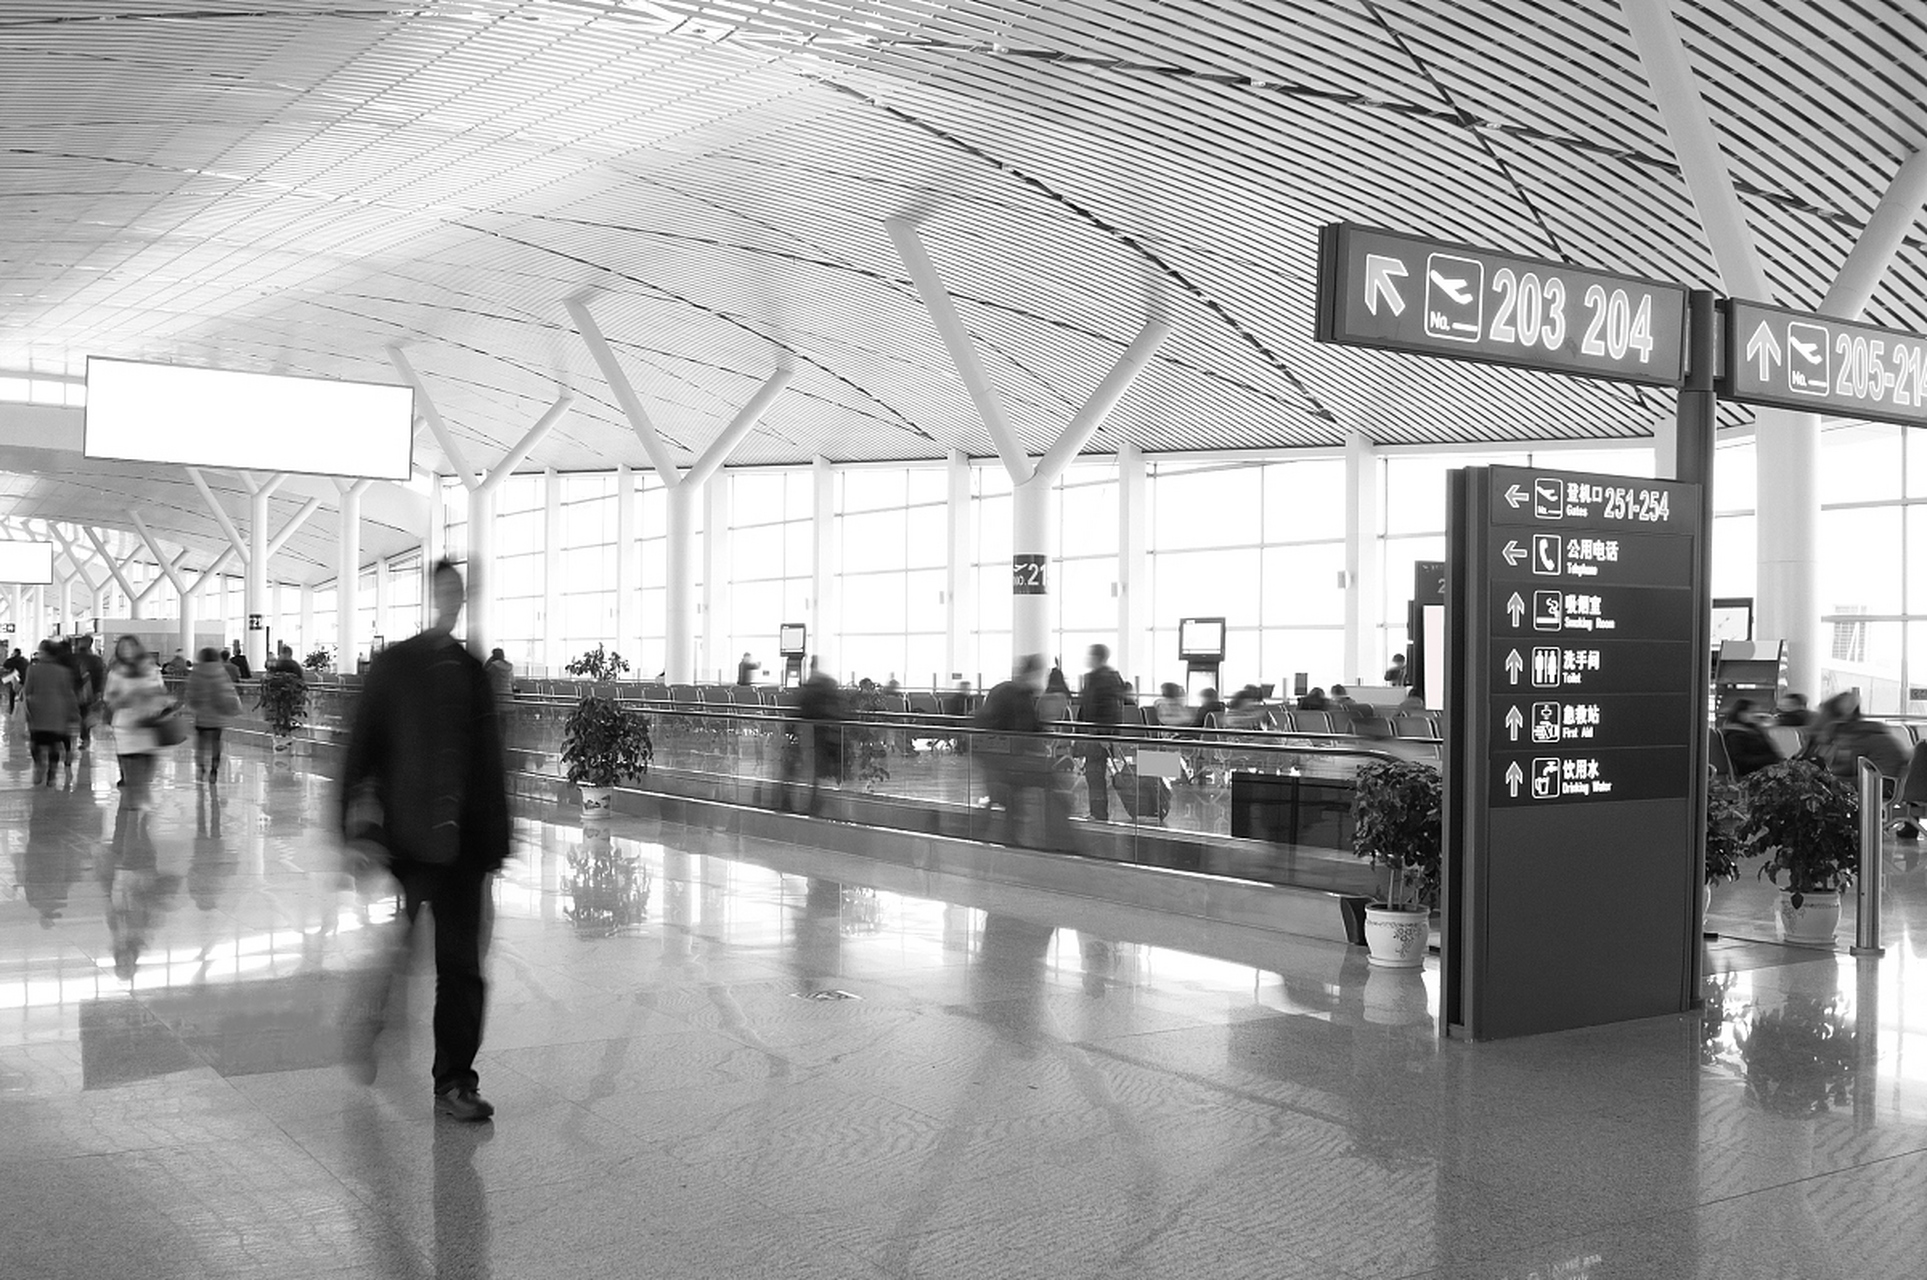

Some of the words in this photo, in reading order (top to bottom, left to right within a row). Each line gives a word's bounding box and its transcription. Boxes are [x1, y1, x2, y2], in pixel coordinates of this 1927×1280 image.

[1430, 310, 1451, 331] No.
[1489, 267, 1566, 350] 203
[1581, 284, 1653, 363] 204
[1566, 482, 1602, 503] 登机口
[1603, 486, 1669, 522] 251-254
[1566, 503, 1588, 518] Gates
[1566, 538, 1619, 561] 公用电话
[1564, 593, 1602, 616] 吸烟室
[1563, 615, 1593, 632] Smoking
[1595, 616, 1616, 629] Room
[1562, 649, 1601, 671] 洗手间
[1561, 671, 1582, 684] Toilet
[1562, 703, 1600, 725] 急救站
[1562, 726, 1579, 739] First
[1581, 725, 1594, 738] Aid
[1562, 758, 1600, 780] 饮用水
[1562, 781, 1590, 796] Drinking
[1592, 779, 1613, 793] Water
